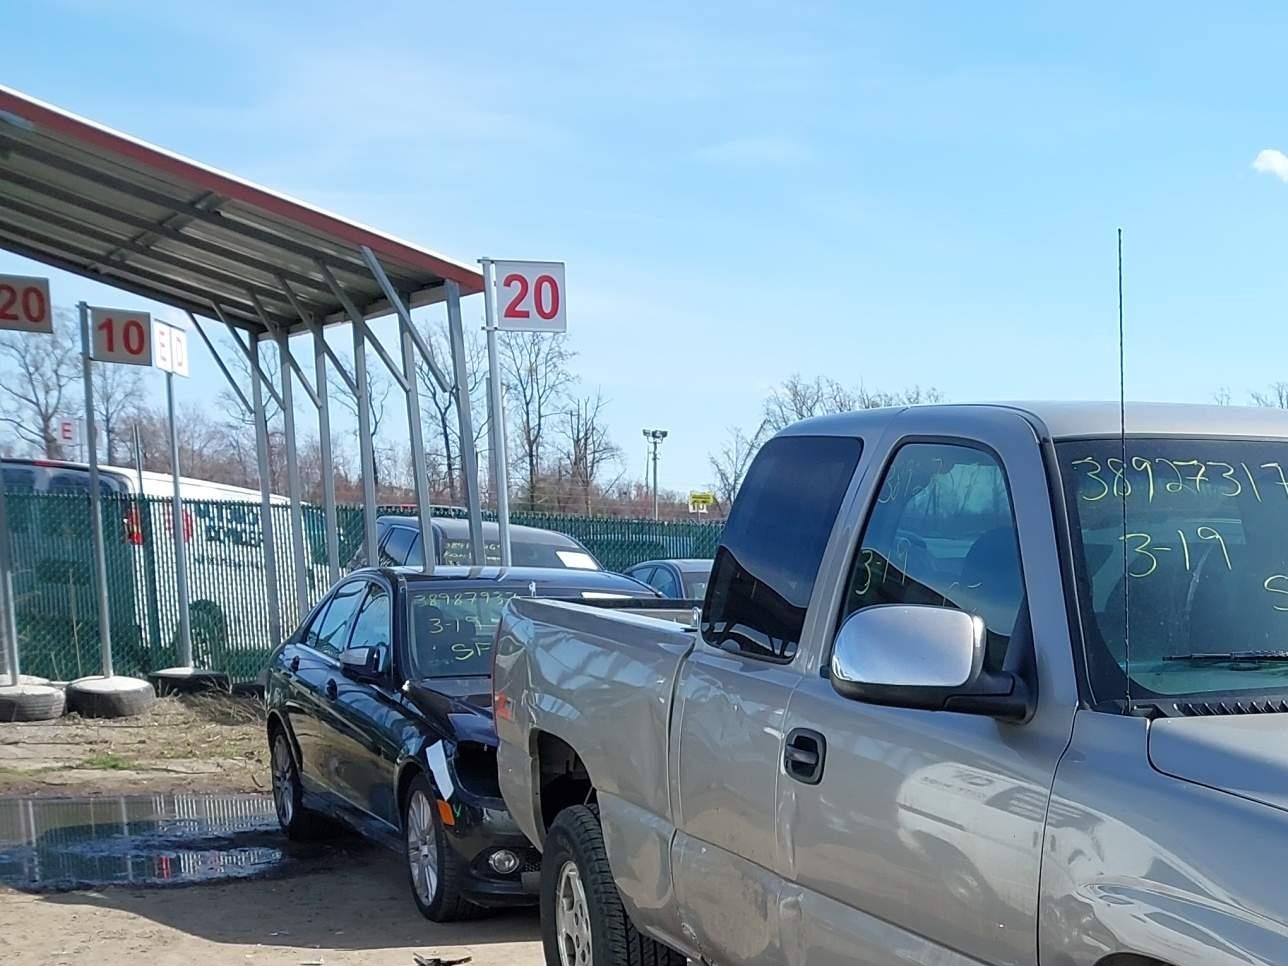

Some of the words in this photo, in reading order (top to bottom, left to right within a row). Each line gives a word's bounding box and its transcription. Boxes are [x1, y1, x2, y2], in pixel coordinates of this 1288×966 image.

[0, 283, 46, 323] 20
[503, 273, 560, 320] 20
[97, 317, 145, 356] 10
[1118, 526, 1232, 578] 3-19
[429, 616, 482, 635] 3-19
[451, 642, 492, 661] SF
